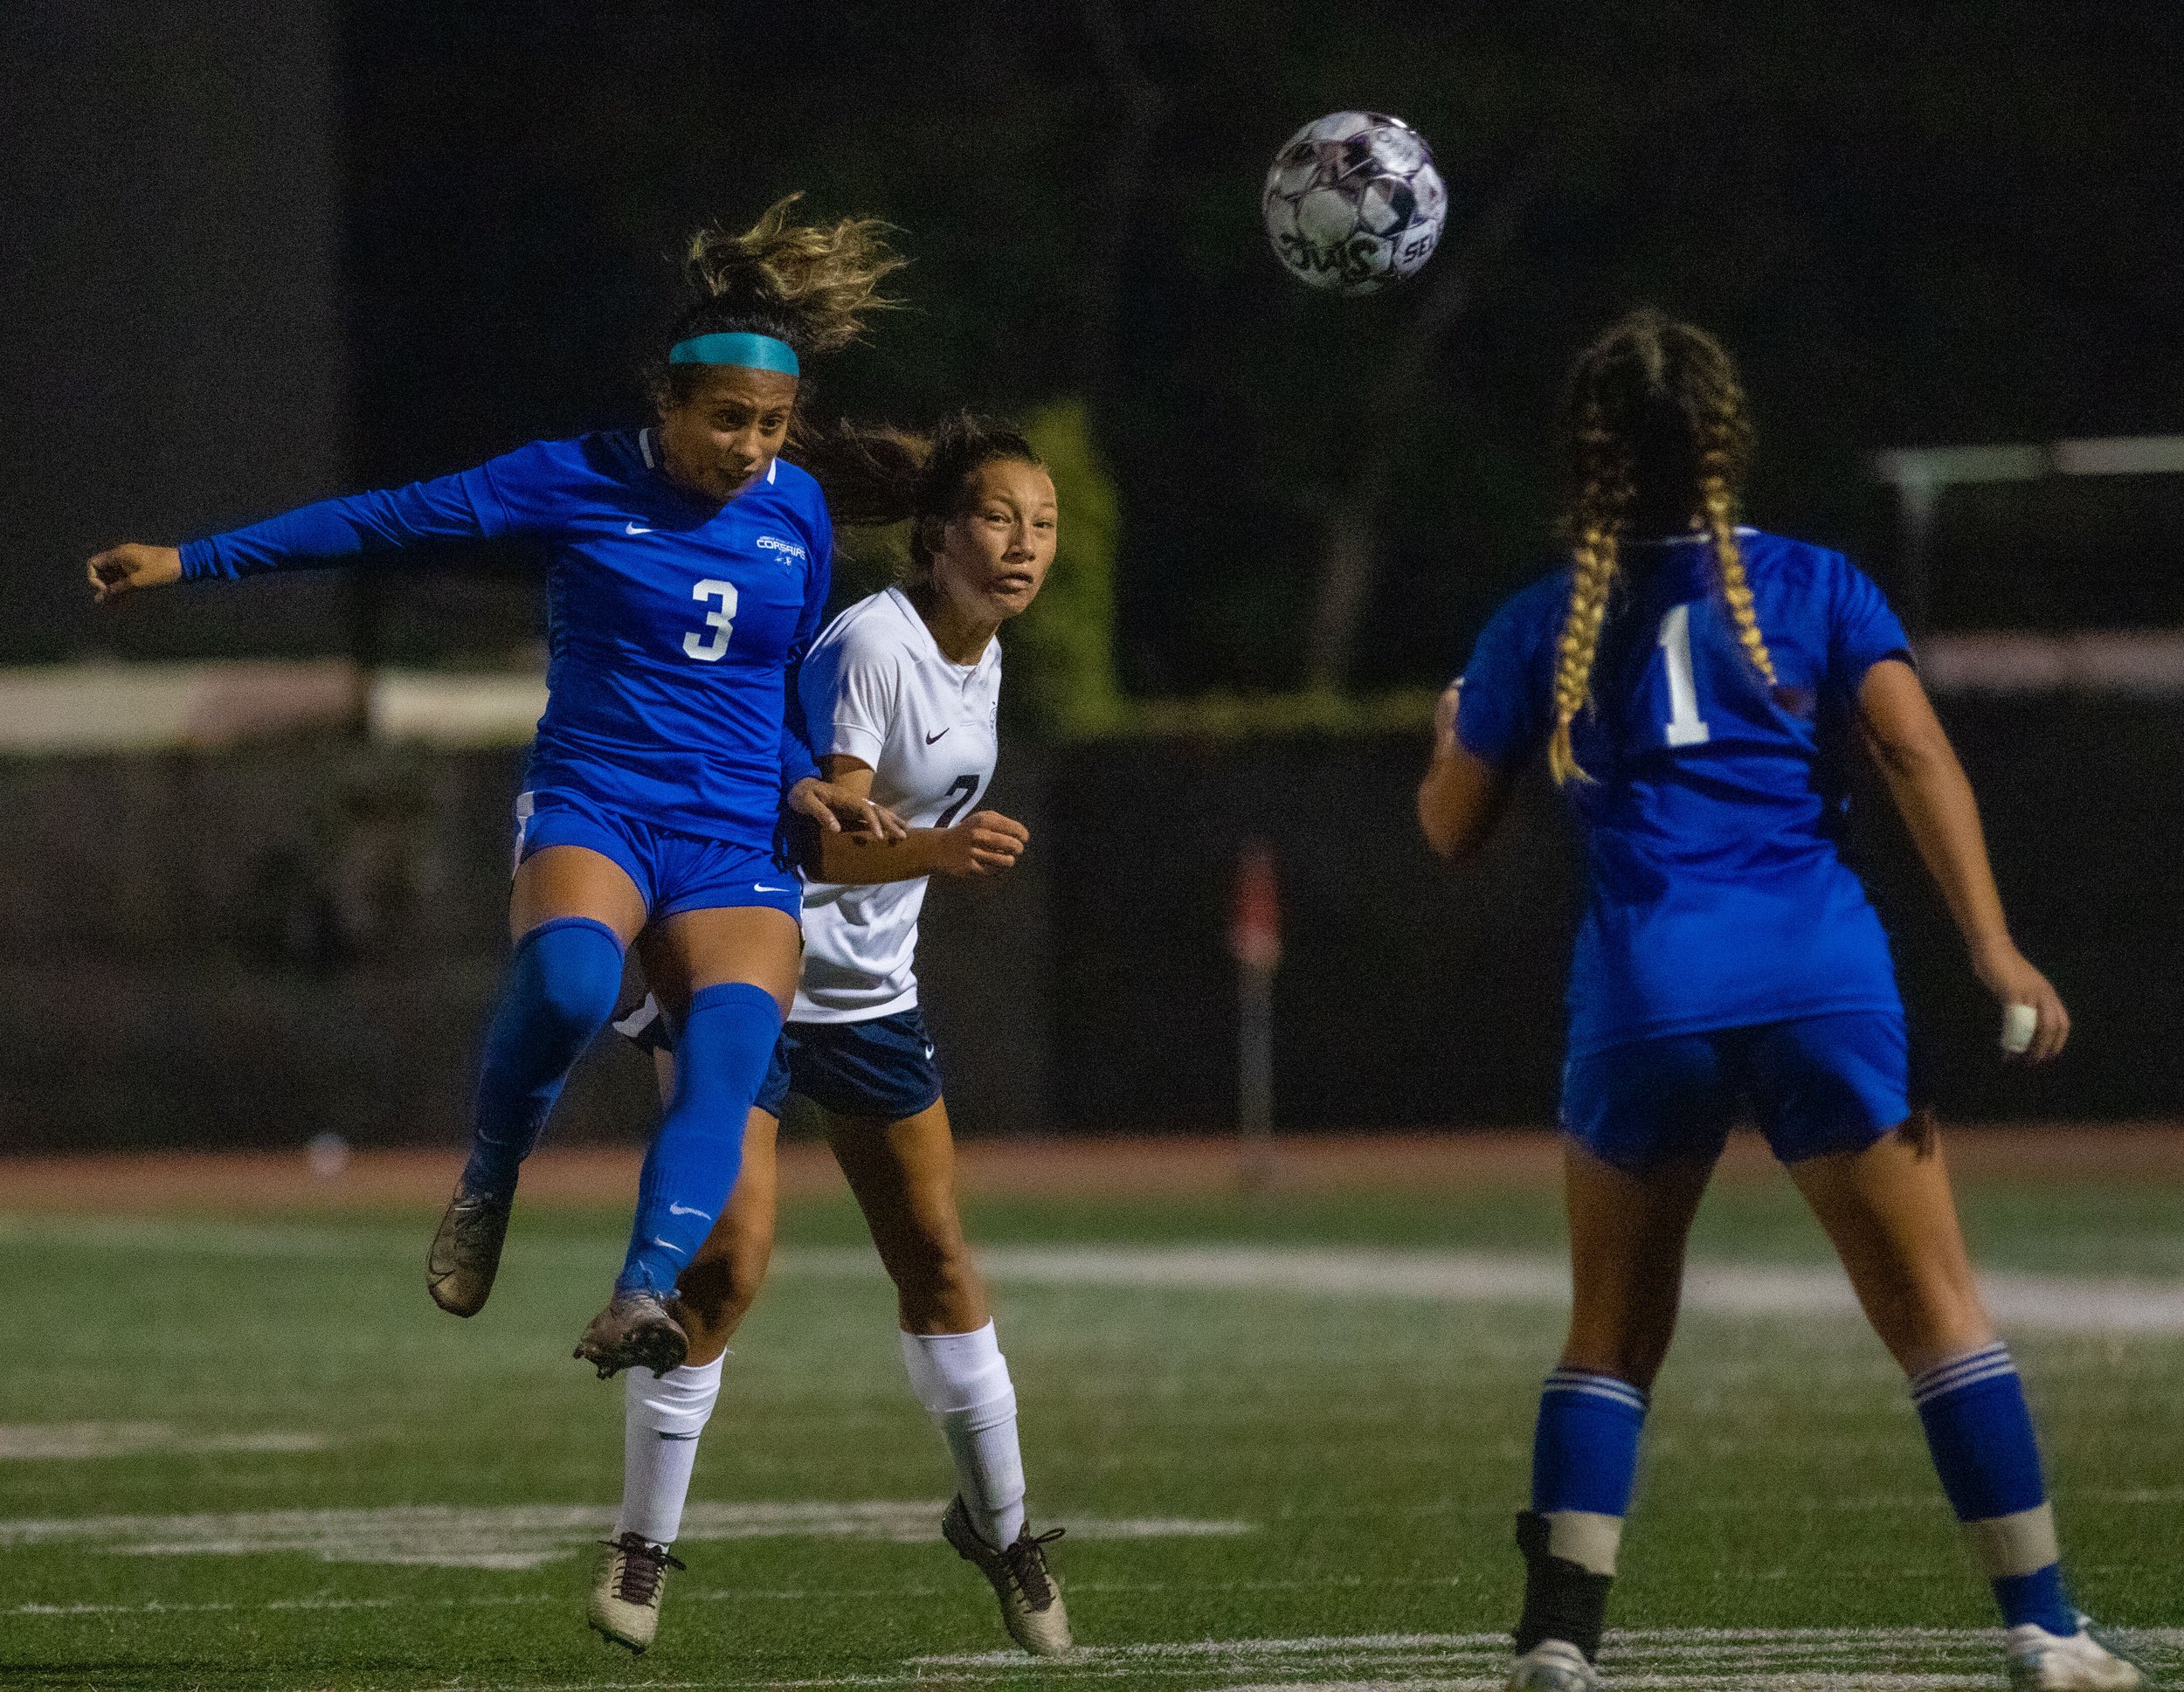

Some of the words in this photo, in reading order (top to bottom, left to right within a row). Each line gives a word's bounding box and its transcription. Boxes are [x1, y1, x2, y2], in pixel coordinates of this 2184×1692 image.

[756, 539, 805, 560] CORSAIRS
[682, 578, 738, 662] 3
[1658, 604, 1710, 748] 1
